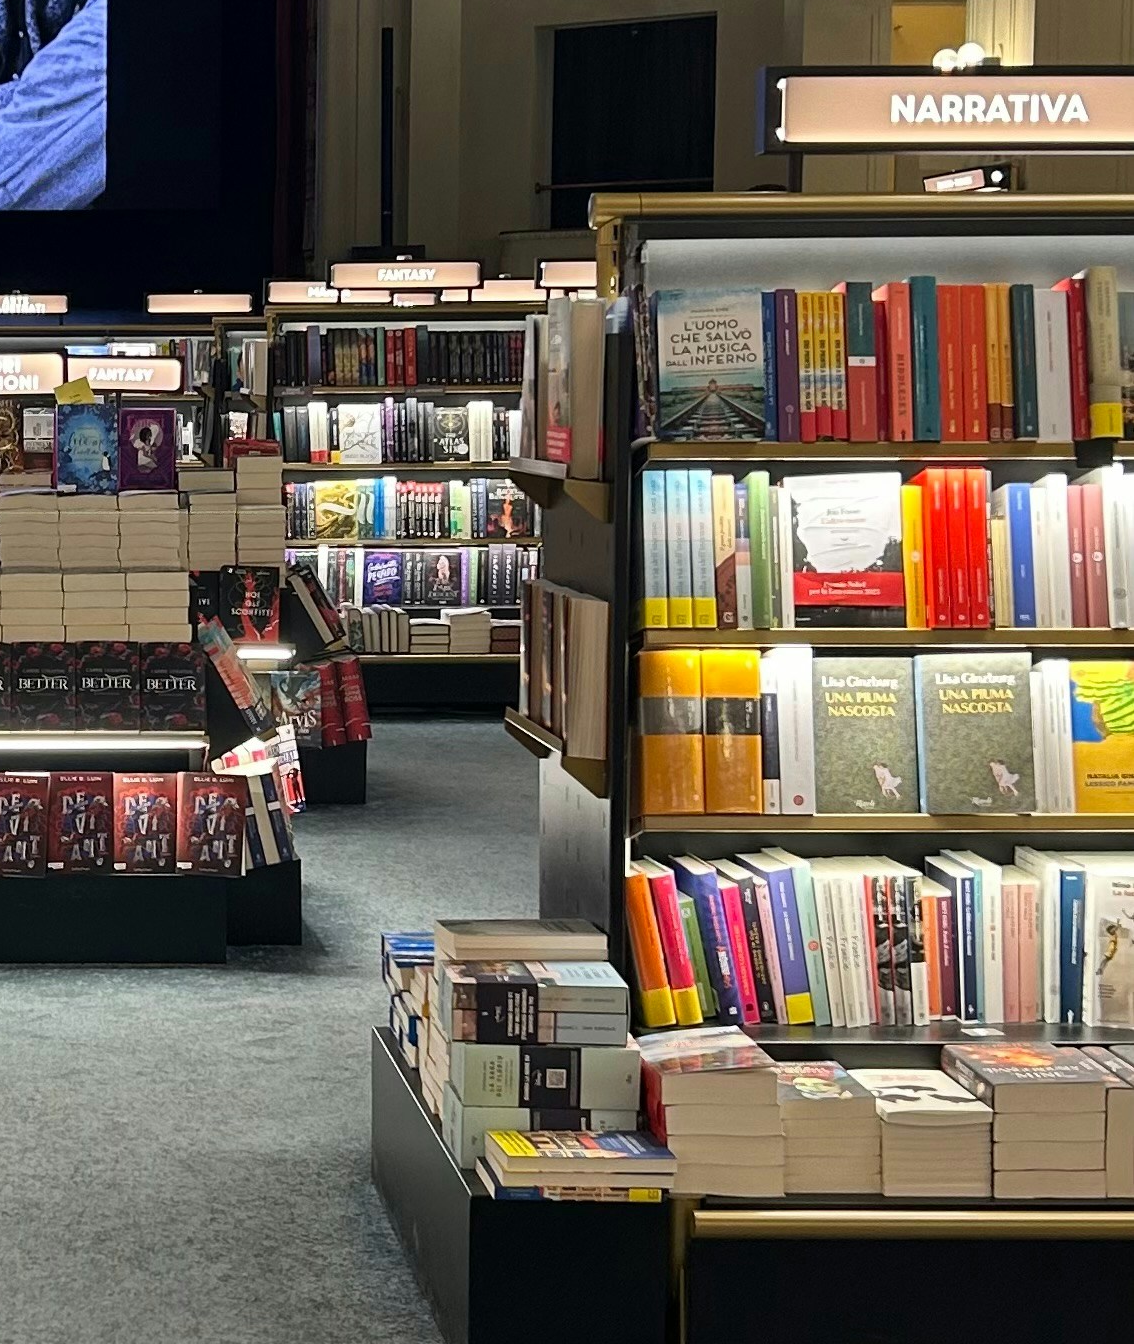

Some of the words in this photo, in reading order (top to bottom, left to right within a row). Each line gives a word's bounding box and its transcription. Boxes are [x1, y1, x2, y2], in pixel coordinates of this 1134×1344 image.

[890, 94, 1090, 124] NARRATIVA
[377, 268, 436, 282] FANTASY
[684, 319, 738, 332] L'UOMO
[670, 333, 701, 344] CHE
[672, 346, 691, 355] LA
[697, 343, 751, 354] MUSICA
[87, 367, 154, 383] FANTASY
[897, 353, 907, 416] MIDDLESEX
[438, 437, 465, 446] ATLAS
[18, 676, 69, 691] BETTER
[81, 675, 132, 690] BETTER
[146, 677, 197, 691] BETTER
[821, 675, 844, 687] Lisa
[846, 675, 898, 690] Ginzburg
[935, 672, 960, 685] Lisa
[962, 671, 1015, 687] Ginzburg
[825, 692, 854, 704] UNA
[859, 691, 897, 704] PIUMA
[939, 689, 968, 701] UNA
[972, 688, 1014, 701] PIUMA
[828, 705, 896, 718] NASCOSTA
[942, 701, 1013, 715] NASCOSTA
